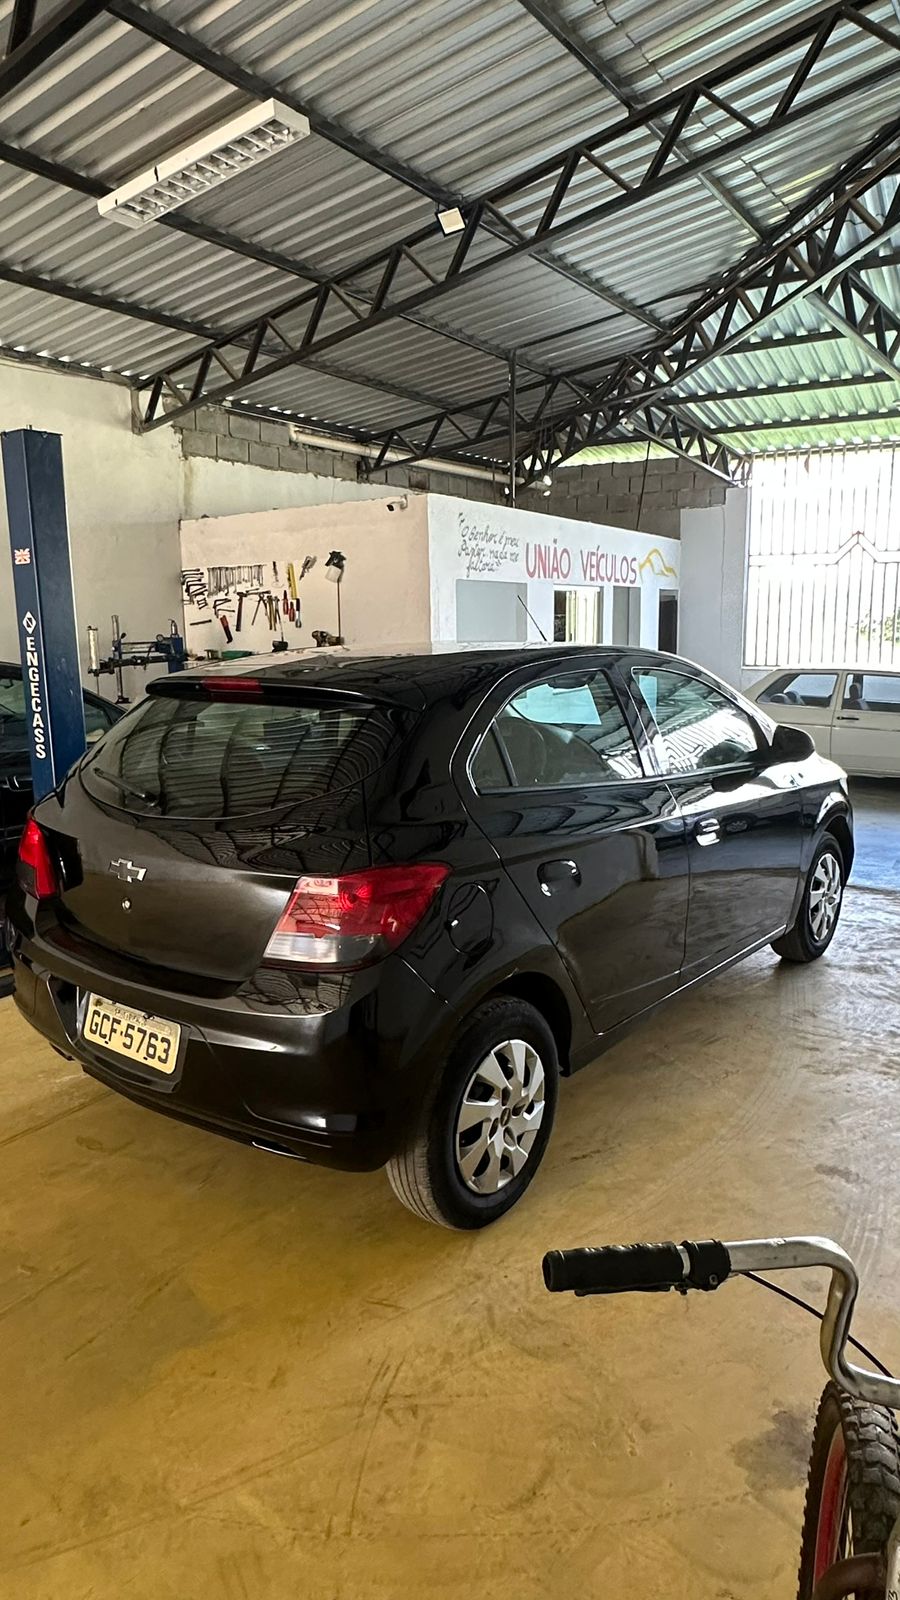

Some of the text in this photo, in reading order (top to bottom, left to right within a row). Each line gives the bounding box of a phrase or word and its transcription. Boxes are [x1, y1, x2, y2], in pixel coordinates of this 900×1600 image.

[525, 538, 638, 584] UNIÃO VEÍCULOS
[26, 636, 47, 760] ENGECASS
